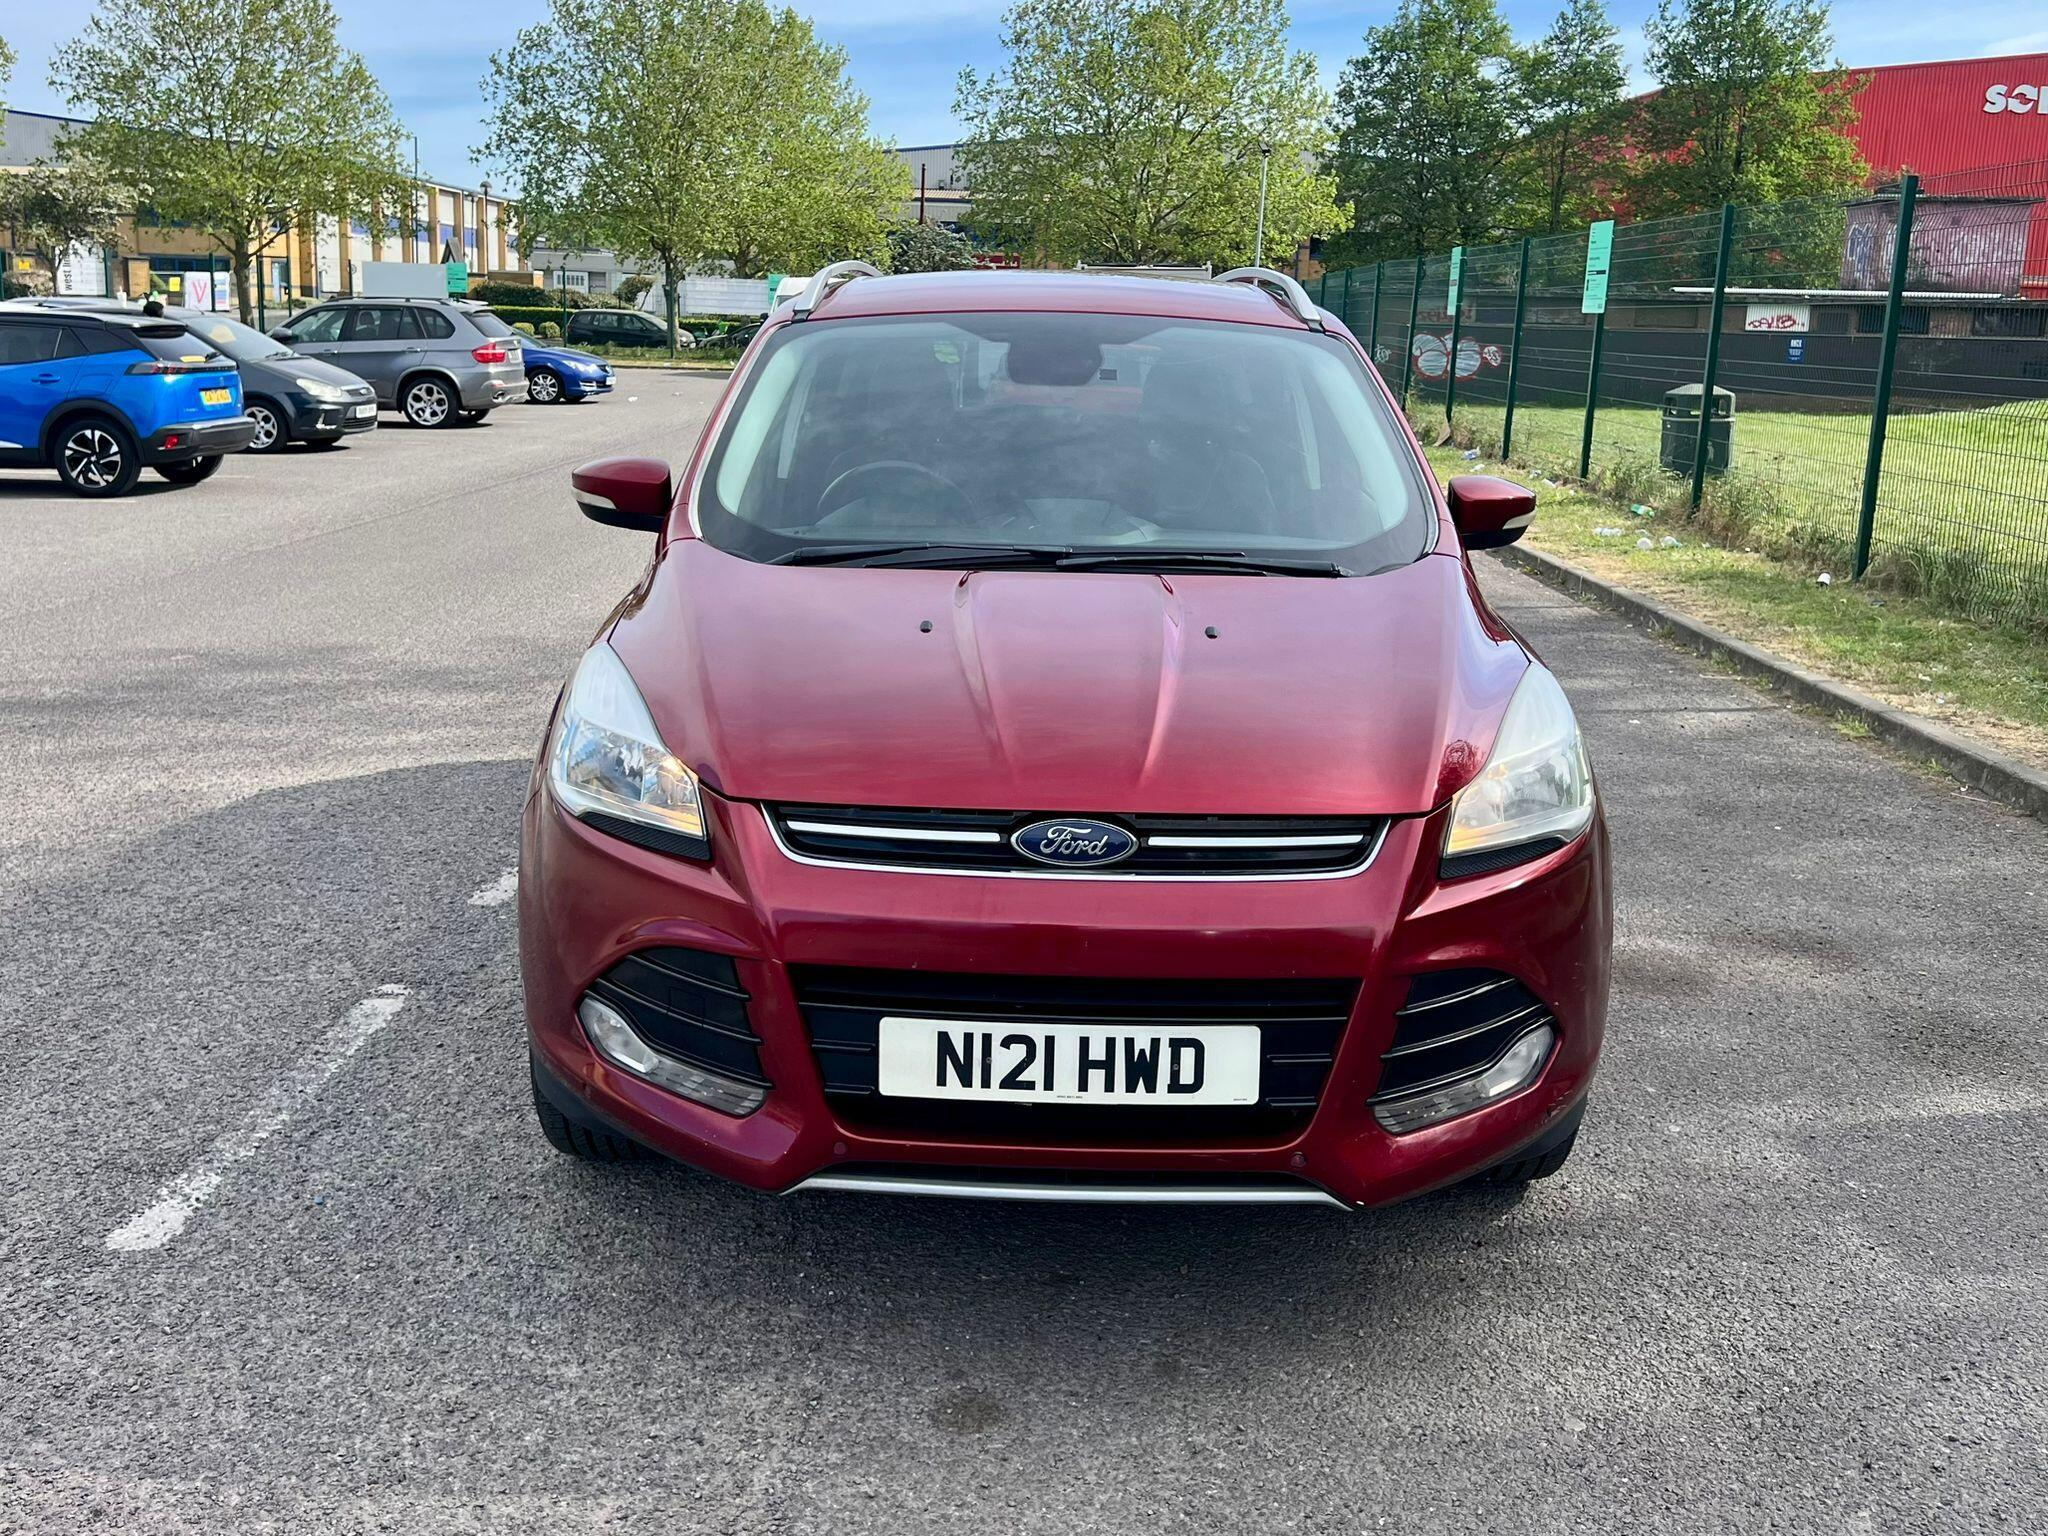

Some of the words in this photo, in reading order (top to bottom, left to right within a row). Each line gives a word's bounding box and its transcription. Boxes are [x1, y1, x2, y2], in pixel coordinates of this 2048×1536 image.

[62, 270, 72, 291] west
[1040, 825, 1109, 855] Ford
[1077, 1036, 1205, 1094] HWD
